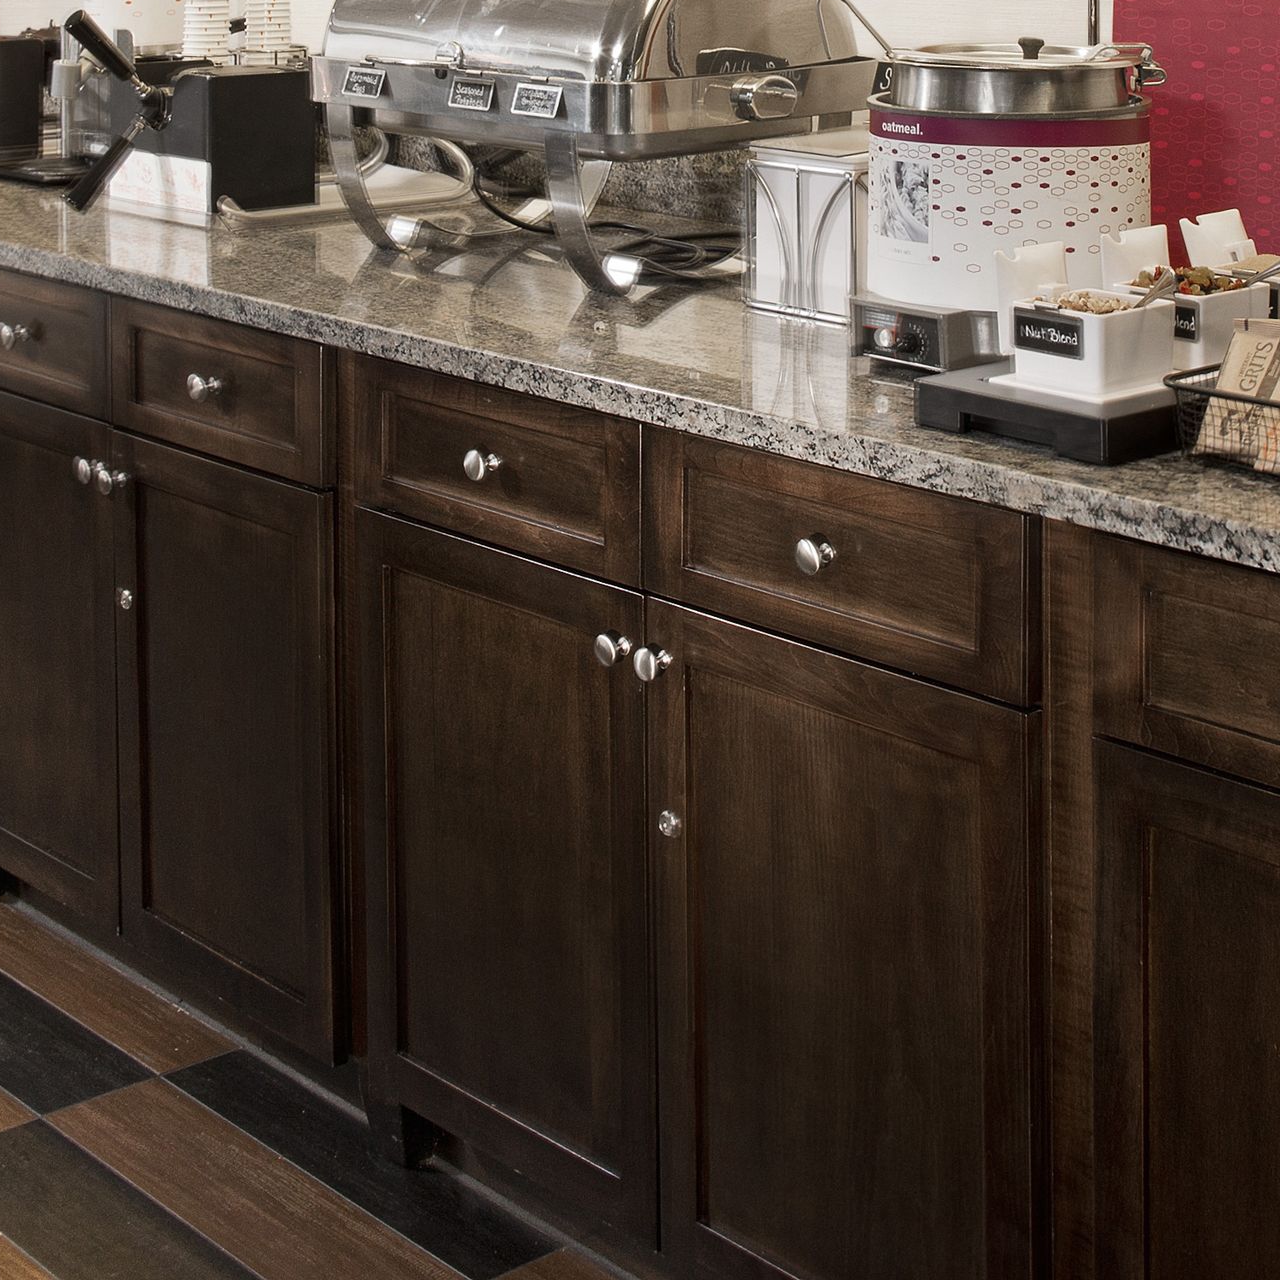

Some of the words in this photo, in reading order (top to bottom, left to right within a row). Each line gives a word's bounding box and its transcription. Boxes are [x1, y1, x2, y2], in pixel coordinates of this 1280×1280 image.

[456, 83, 484, 96] Seasoned
[882, 121, 923, 135] oatmeal.
[1175, 315, 1196, 331] lend
[1024, 324, 1045, 339] Nut
[1048, 328, 1078, 345] Blend
[1239, 342, 1273, 391] GRITS
